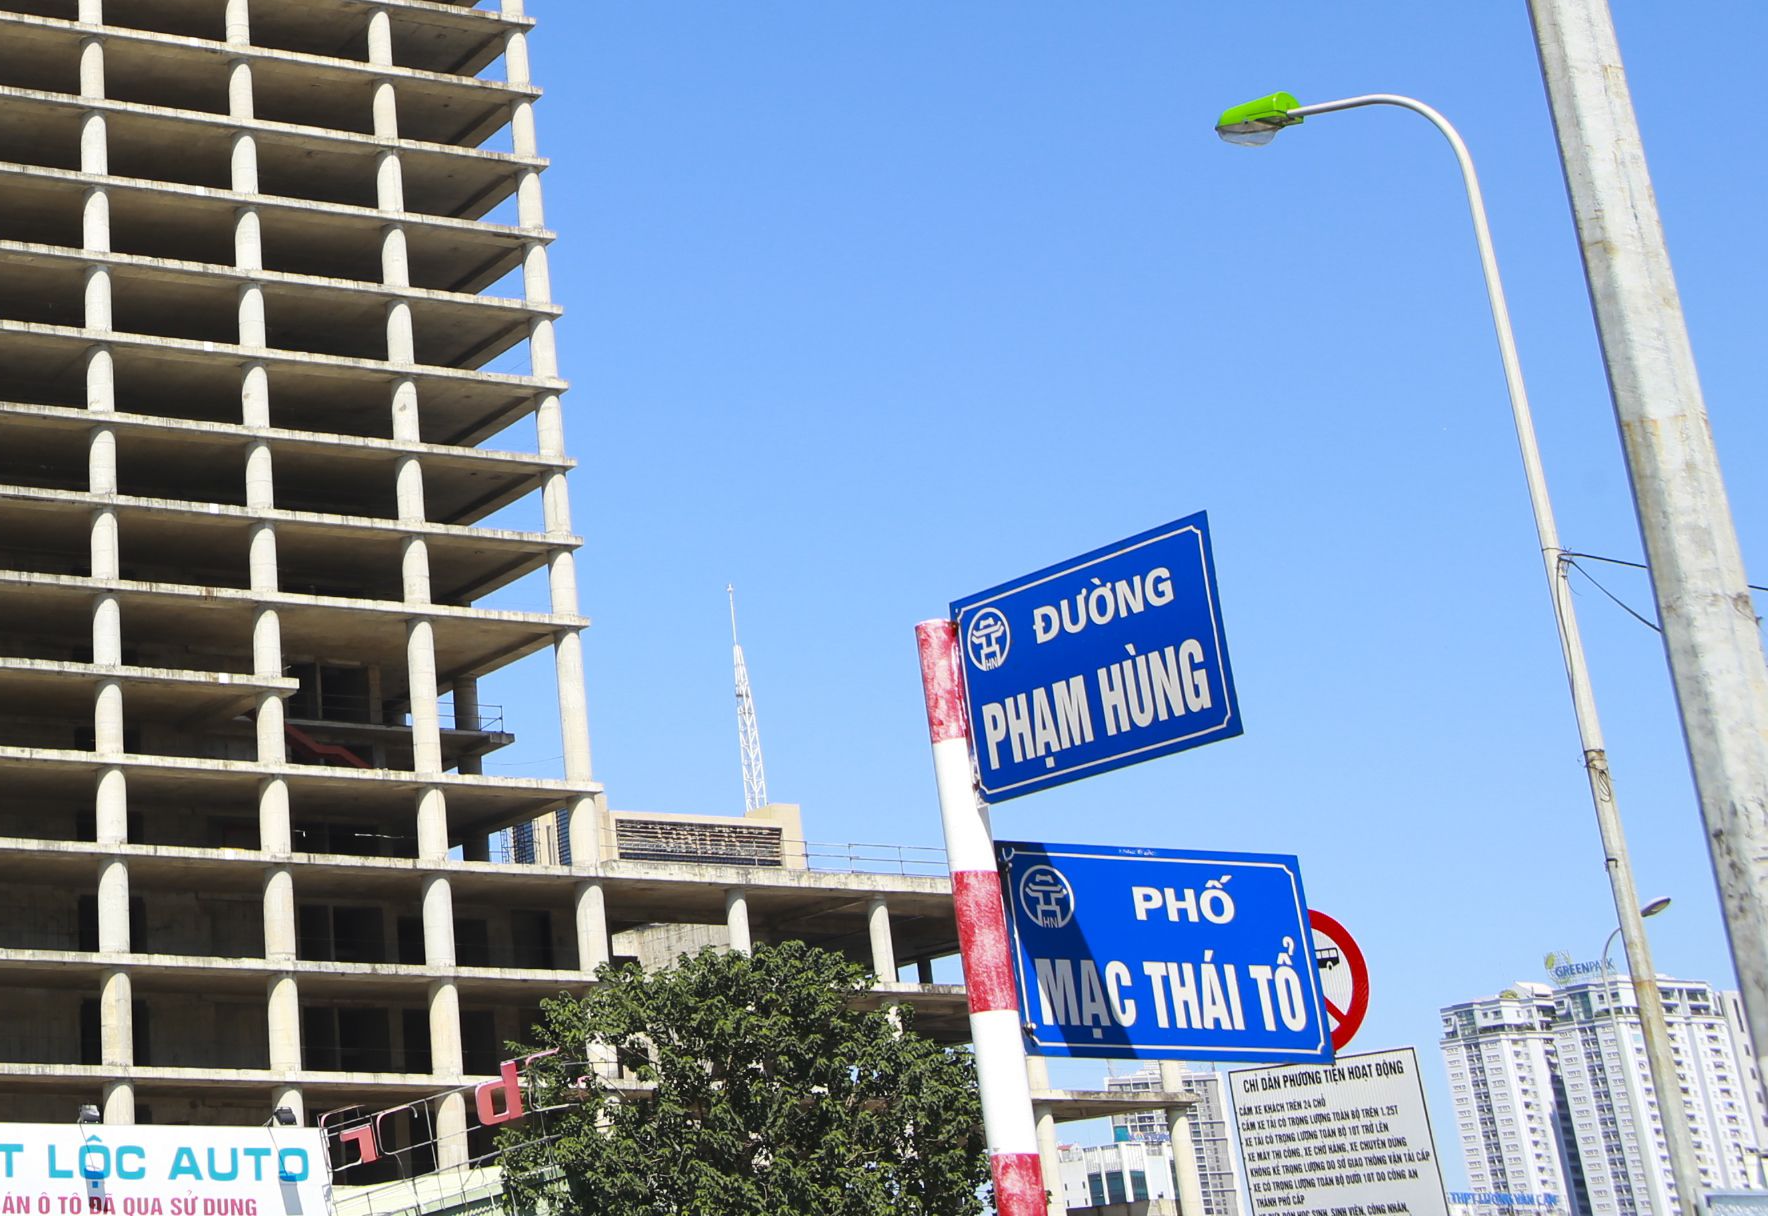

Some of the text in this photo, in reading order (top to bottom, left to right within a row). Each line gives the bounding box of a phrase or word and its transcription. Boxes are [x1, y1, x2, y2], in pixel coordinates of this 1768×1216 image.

[1033, 567, 1174, 644] ĐƯỜNG
[982, 639, 1213, 769] PHẠM HÙNG
[1132, 875, 1235, 925] PHỐ
[1555, 958, 1614, 978] GREENPAK
[1034, 935, 1307, 1040] MẠC THÁI TỔ
[1243, 1071, 1259, 1093] CHỈ
[1283, 1070, 1322, 1088] PHƯƠNG
[1323, 1065, 1346, 1085] TIỆN
[1348, 1063, 1373, 1082] HOẠT
[1375, 1059, 1404, 1078] ĐỘNG
[1254, 1105, 1262, 1115] XE
[1303, 1100, 1311, 1109] 24
[1257, 1120, 1266, 1130] XE
[1244, 1137, 1253, 1147] XE
[1247, 1152, 1255, 1162] XE
[1304, 1145, 1312, 1156] XE
[1350, 1142, 1358, 1152] XE
[48, 1134, 146, 1188] LỘC
[168, 1146, 310, 1182] AUTO
[1253, 1182, 1261, 1192] XE
[37, 1191, 50, 1215] Ô
[57, 1192, 83, 1215] TÔ
[89, 1193, 116, 1216] ĐÃ
[122, 1197, 163, 1216] QUA
[170, 1189, 197, 1216] SỬ
